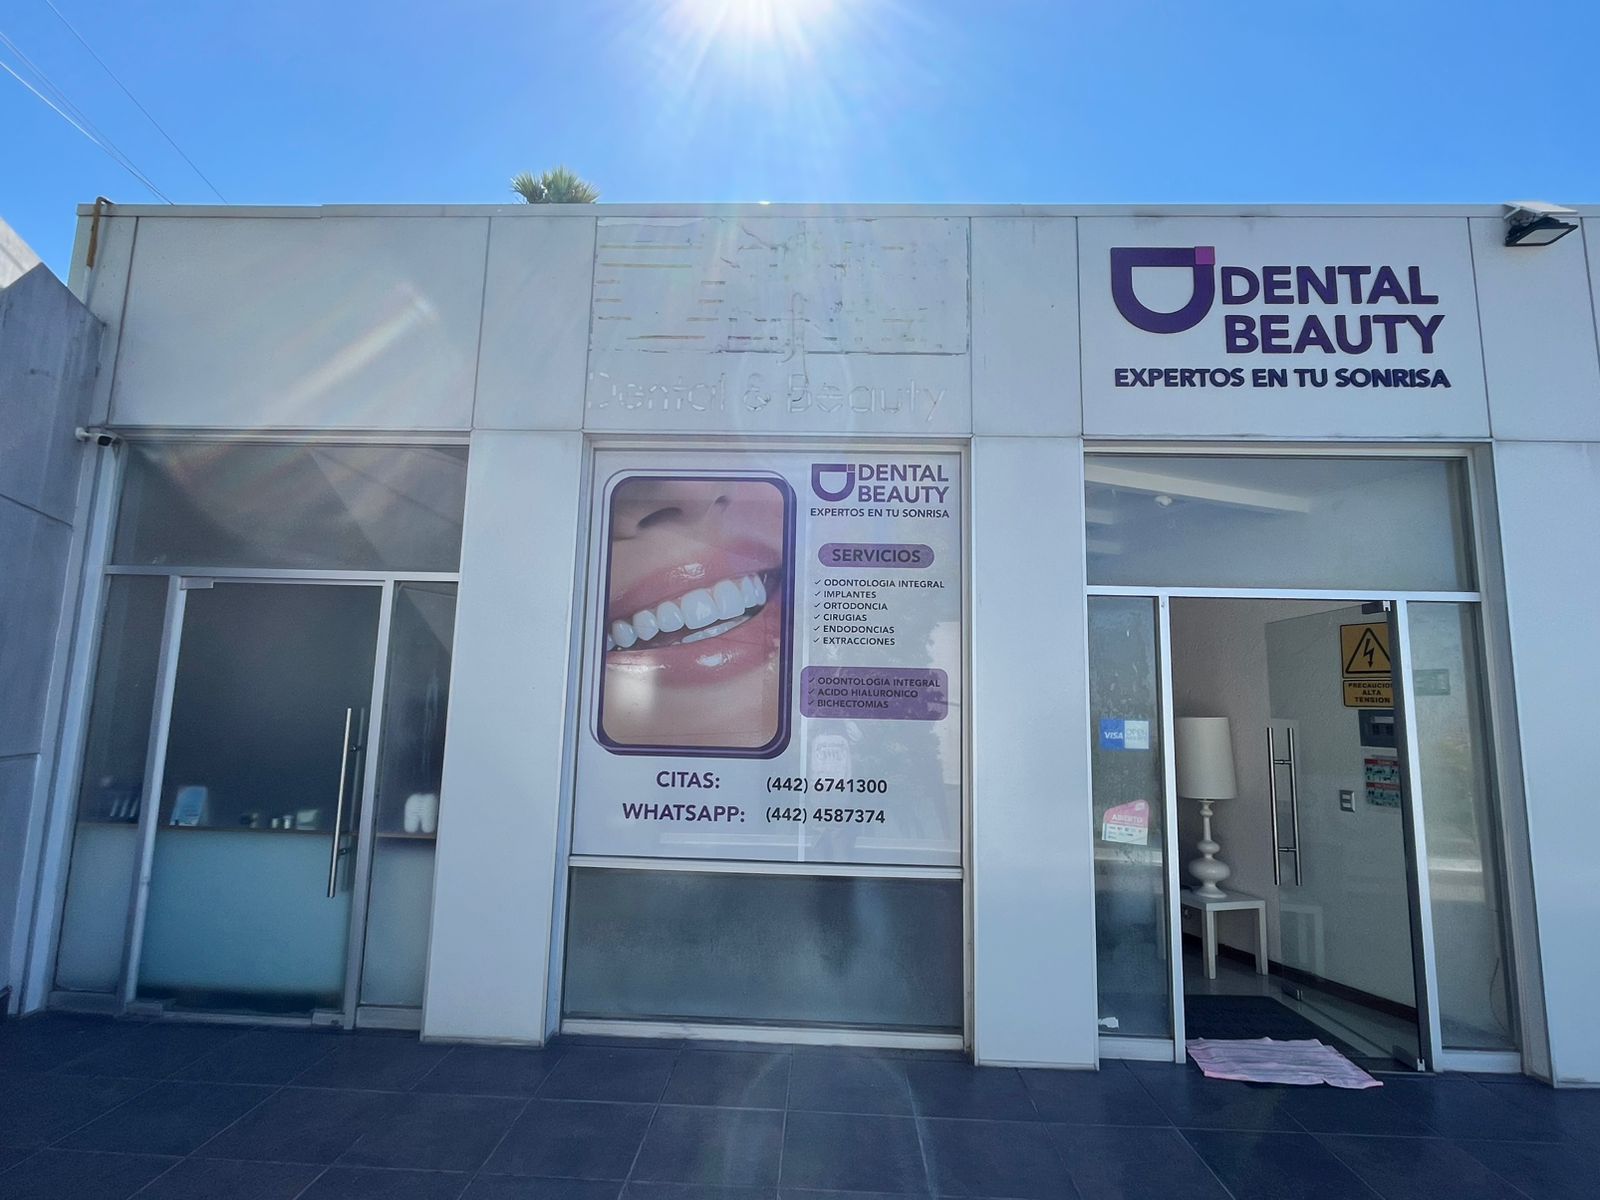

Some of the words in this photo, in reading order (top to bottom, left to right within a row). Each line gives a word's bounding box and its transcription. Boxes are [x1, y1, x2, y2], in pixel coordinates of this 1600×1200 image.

[1221, 265, 1439, 305] DENTAL
[1226, 314, 1445, 354] BEAUTY
[1114, 368, 1245, 388] EXPERTOS
[1252, 368, 1288, 388] EN
[1294, 368, 1328, 388] TU
[1335, 368, 1452, 388] SONRISA
[858, 464, 949, 482] DENTAL
[858, 485, 950, 503] BEAUTY
[810, 507, 865, 517] EXPERTOS
[868, 508, 883, 518] EN
[886, 509, 900, 518] TU
[902, 509, 950, 518] SONRISA
[832, 548, 921, 563] SERVICIOS
[824, 578, 896, 588] ODONTOLOGIA
[898, 579, 945, 589] INTEGRAL
[823, 590, 877, 599] IMPLANTES
[823, 602, 888, 611] ORTODONCIA
[823, 613, 867, 622] CIRUGIAS
[823, 625, 895, 634] ENDODONCIAS
[823, 637, 896, 646] EXTRACCIONES
[817, 677, 891, 687] ODONTOLOGIA
[893, 678, 941, 688] INTEGRAL
[817, 688, 849, 697] ACIDO
[851, 688, 919, 698] HIALURONICO
[817, 699, 889, 709] BICHECTOMIAS
[1104, 731, 1123, 740] VISA
[656, 770, 720, 790] CITAS:
[766, 776, 809, 794] (442)
[813, 778, 888, 794] 6741300
[622, 802, 746, 823] WHATSAPP:
[765, 807, 808, 825] (442)
[812, 808, 887, 824] 4587374
